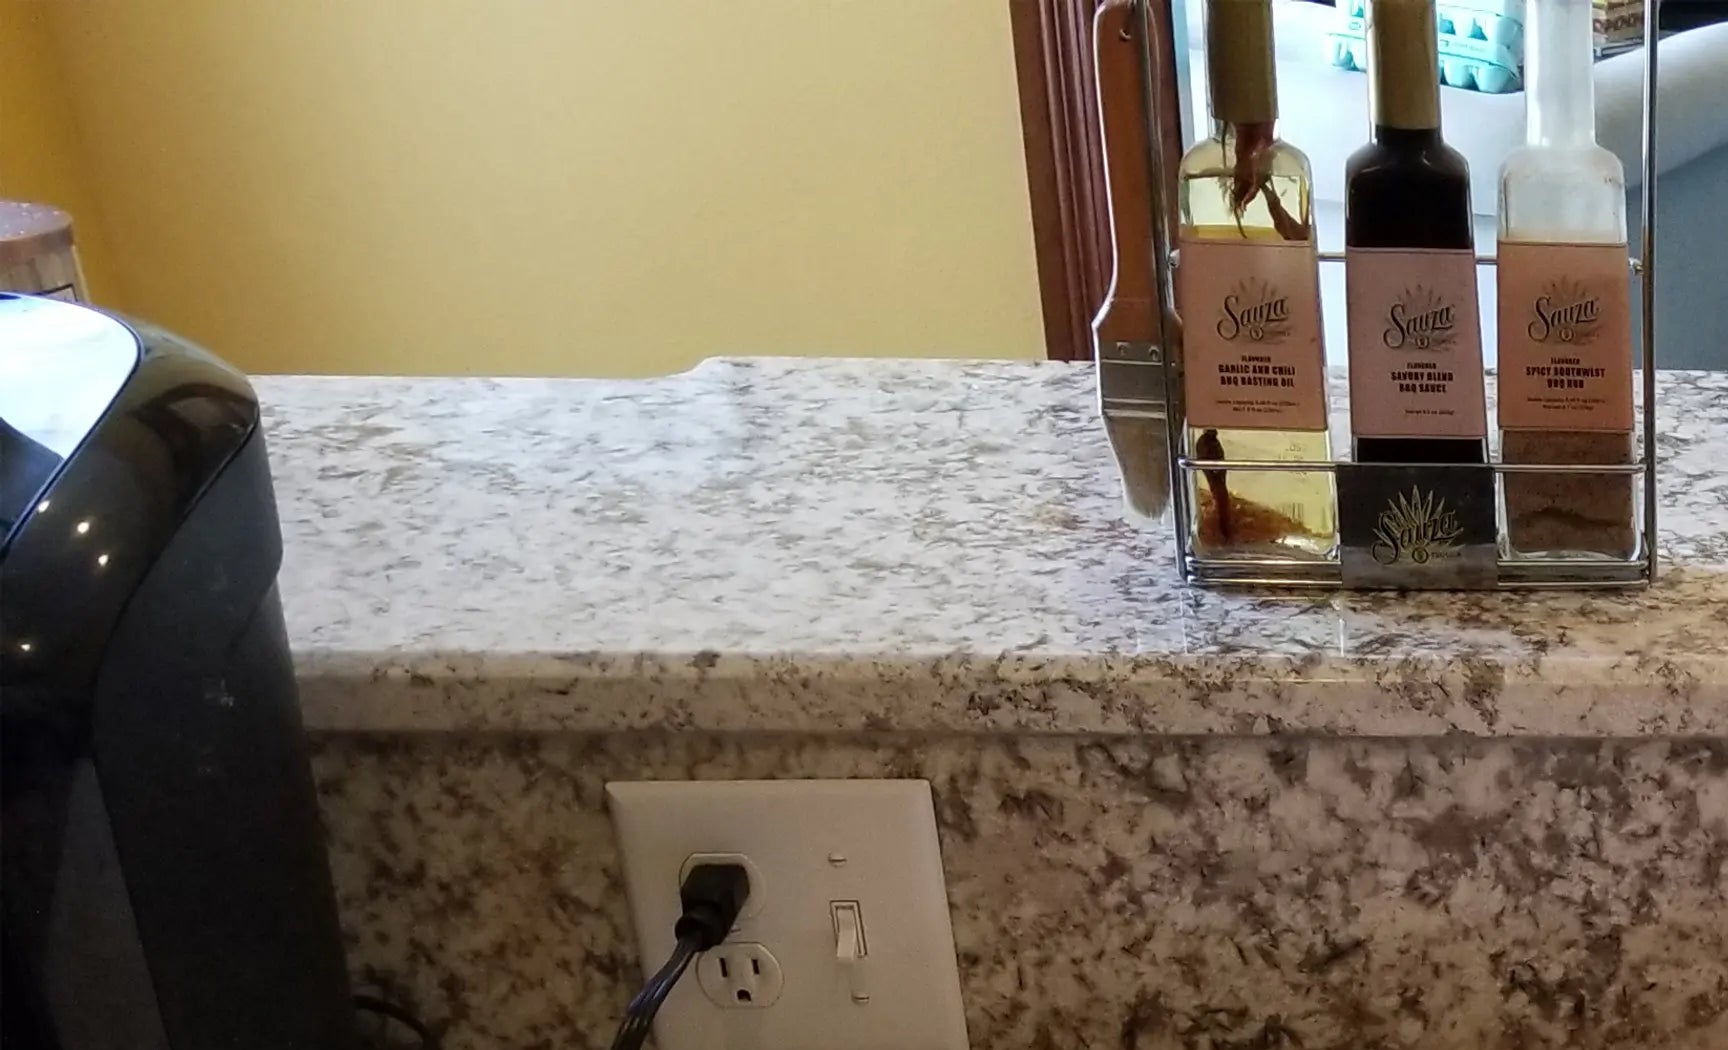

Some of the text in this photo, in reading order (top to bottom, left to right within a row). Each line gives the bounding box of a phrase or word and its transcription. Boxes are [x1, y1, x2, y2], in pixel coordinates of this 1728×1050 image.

[1217, 295, 1289, 341] Sauza
[1528, 296, 1600, 342] Sauza
[1383, 304, 1456, 349] Sauza
[1218, 364, 1295, 376] GARLIC AND CHILI
[1391, 371, 1424, 381] SAVORY
[1526, 366, 1605, 378] SPICY SOUTHWEST
[1220, 376, 1295, 388] BBQ BASTING OIL
[1399, 383, 1447, 393] BBQ SAUCE
[1372, 509, 1464, 565] Sauza
